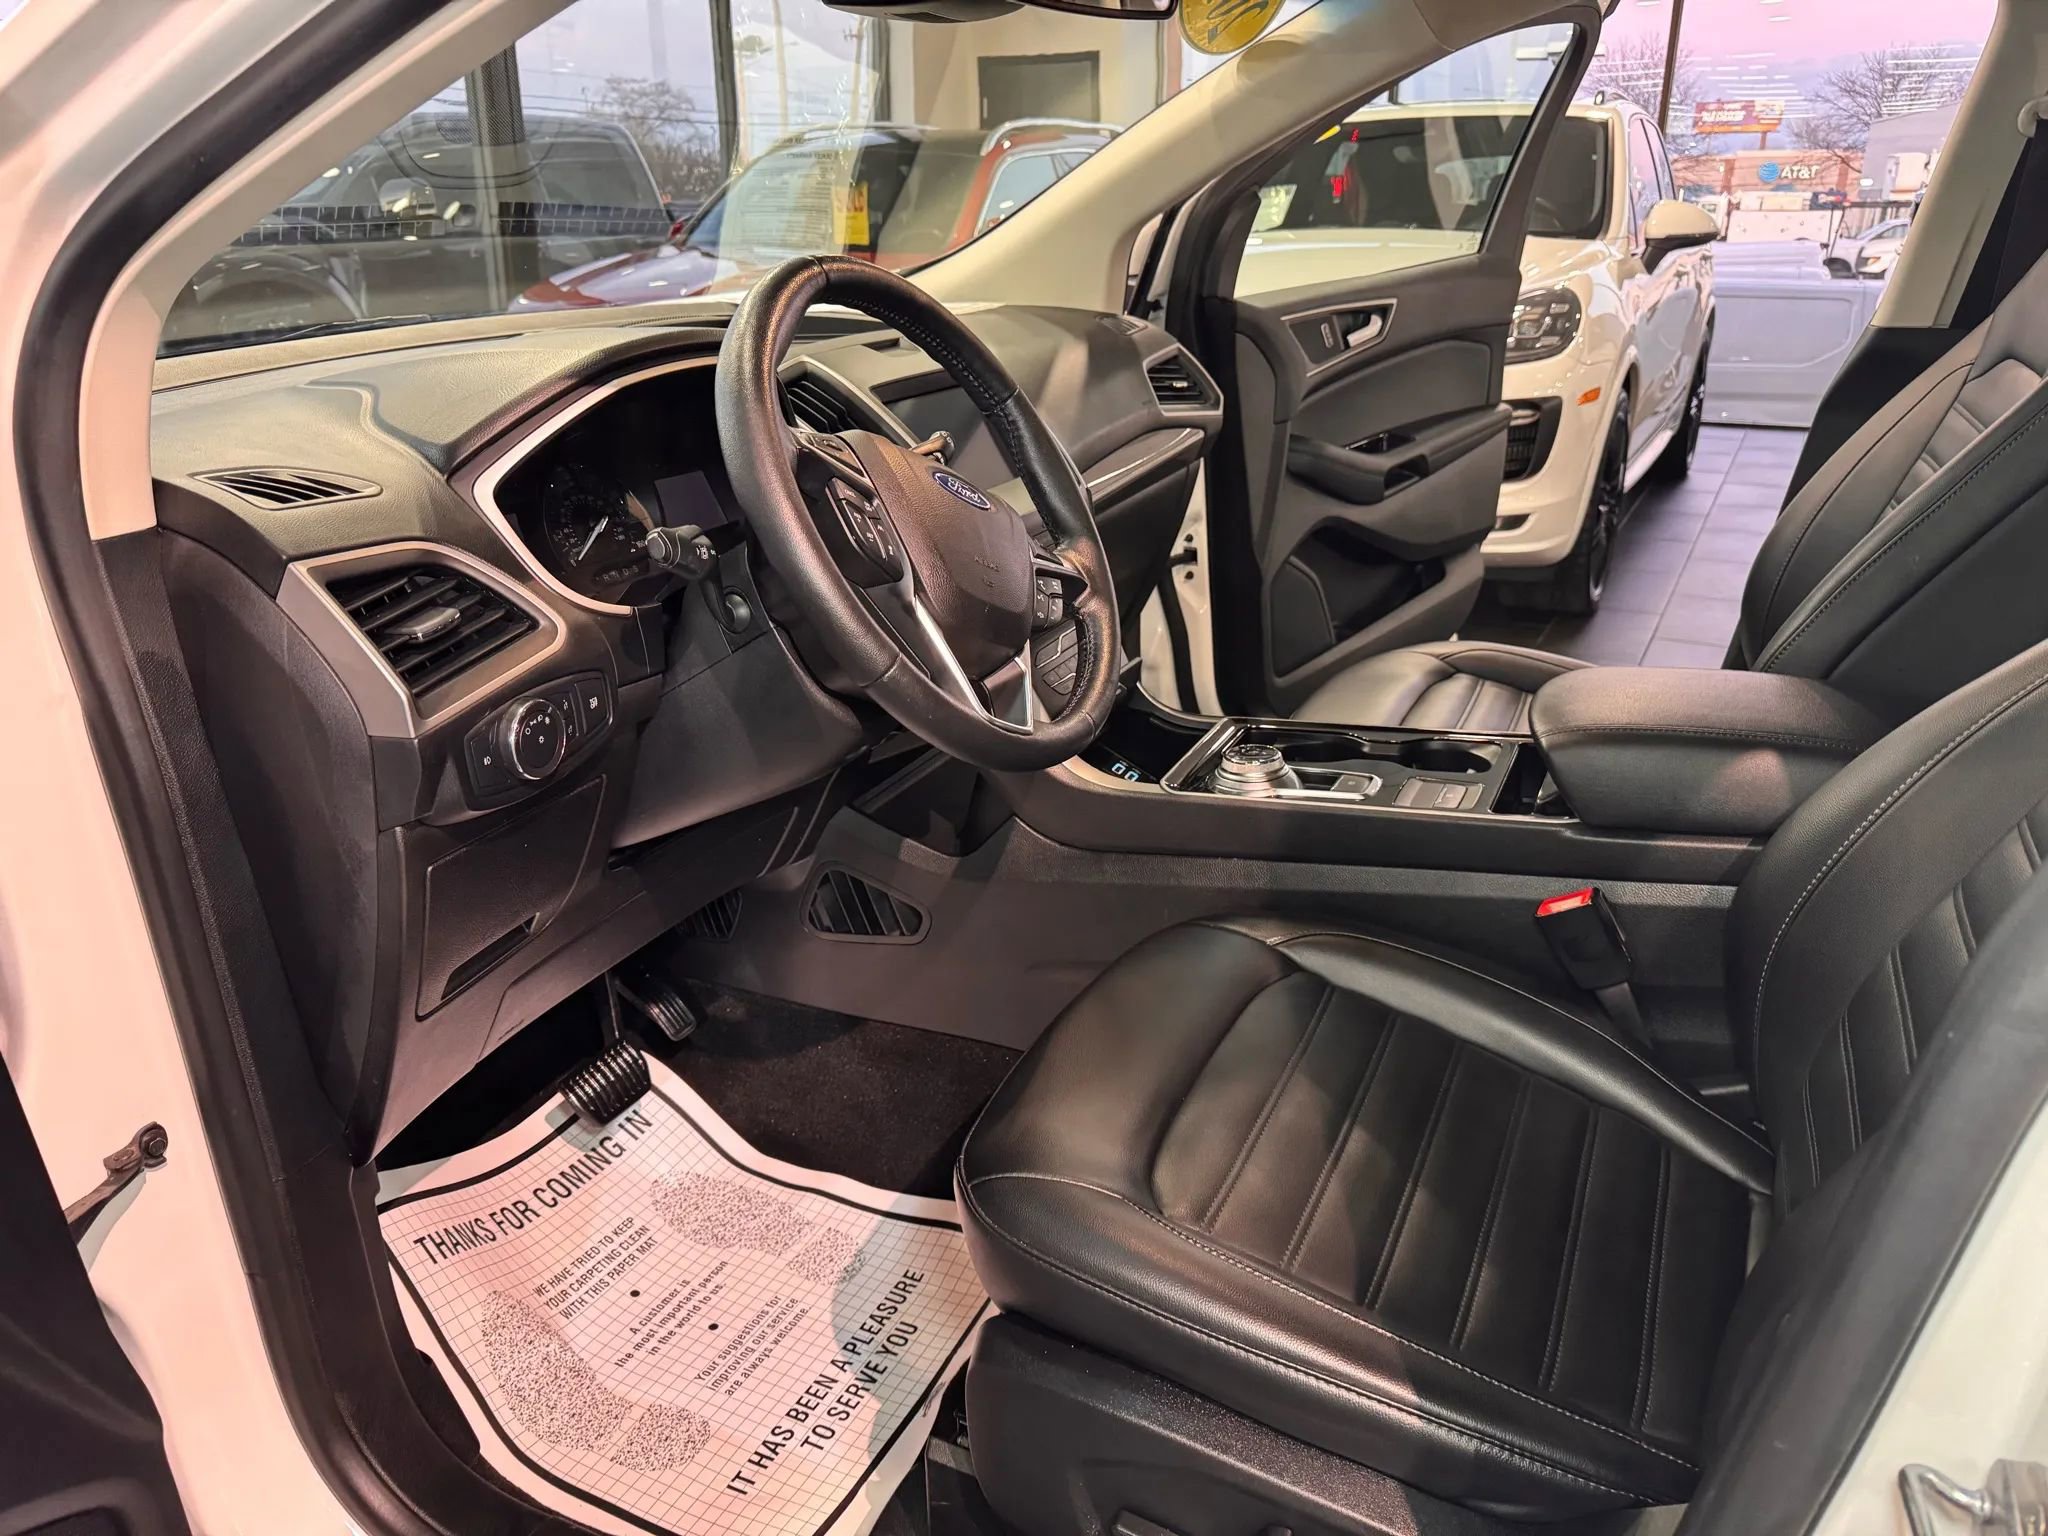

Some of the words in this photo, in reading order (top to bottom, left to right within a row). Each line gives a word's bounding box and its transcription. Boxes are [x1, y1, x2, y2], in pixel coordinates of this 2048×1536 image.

[1780, 165, 1819, 179] AT&T
[947, 477, 981, 505] Ford
[413, 1217, 497, 1264] THANKS
[488, 1200, 541, 1236] FOR
[532, 1135, 627, 1208] COMING
[617, 1109, 653, 1141] IN
[532, 1282, 550, 1298] WE
[546, 1266, 574, 1289] HAVE
[570, 1245, 601, 1271] TRIED
[597, 1235, 615, 1249] TO
[611, 1216, 635, 1238] KEEP
[543, 1289, 572, 1311] YOUR
[568, 1248, 622, 1293] CARPETING
[619, 1224, 651, 1251] CLEAN
[559, 1298, 589, 1320] WITH
[583, 1278, 610, 1299] THIS
[606, 1253, 640, 1281] PAPER
[636, 1236, 659, 1256] MAT
[614, 1352, 634, 1368] the
[632, 1328, 659, 1352] most
[654, 1288, 700, 1328] important
[697, 1260, 729, 1289] person
[629, 1326, 641, 1335] A
[638, 1288, 681, 1327] customer
[677, 1279, 691, 1288] is
[645, 1346, 661, 1356] in
[656, 1330, 677, 1345] the
[674, 1304, 701, 1329] world
[697, 1295, 712, 1305] to
[709, 1282, 727, 1295] us.
[694, 1360, 720, 1382] Your
[717, 1309, 770, 1361] suggestions
[765, 1295, 782, 1309] for
[706, 1346, 756, 1391] improving
[752, 1329, 769, 1346] our
[767, 1298, 799, 1330] service
[724, 1380, 743, 1397] are
[740, 1347, 773, 1379] always
[770, 1306, 812, 1346] welcome.
[726, 1470, 756, 1495] IT
[747, 1425, 795, 1470] HAS
[785, 1373, 839, 1423] BEEN
[829, 1359, 853, 1373] A
[842, 1269, 925, 1356] PLEASURE
[800, 1424, 836, 1451] TO
[826, 1359, 889, 1421] SERVE
[875, 1322, 919, 1357] YOU
